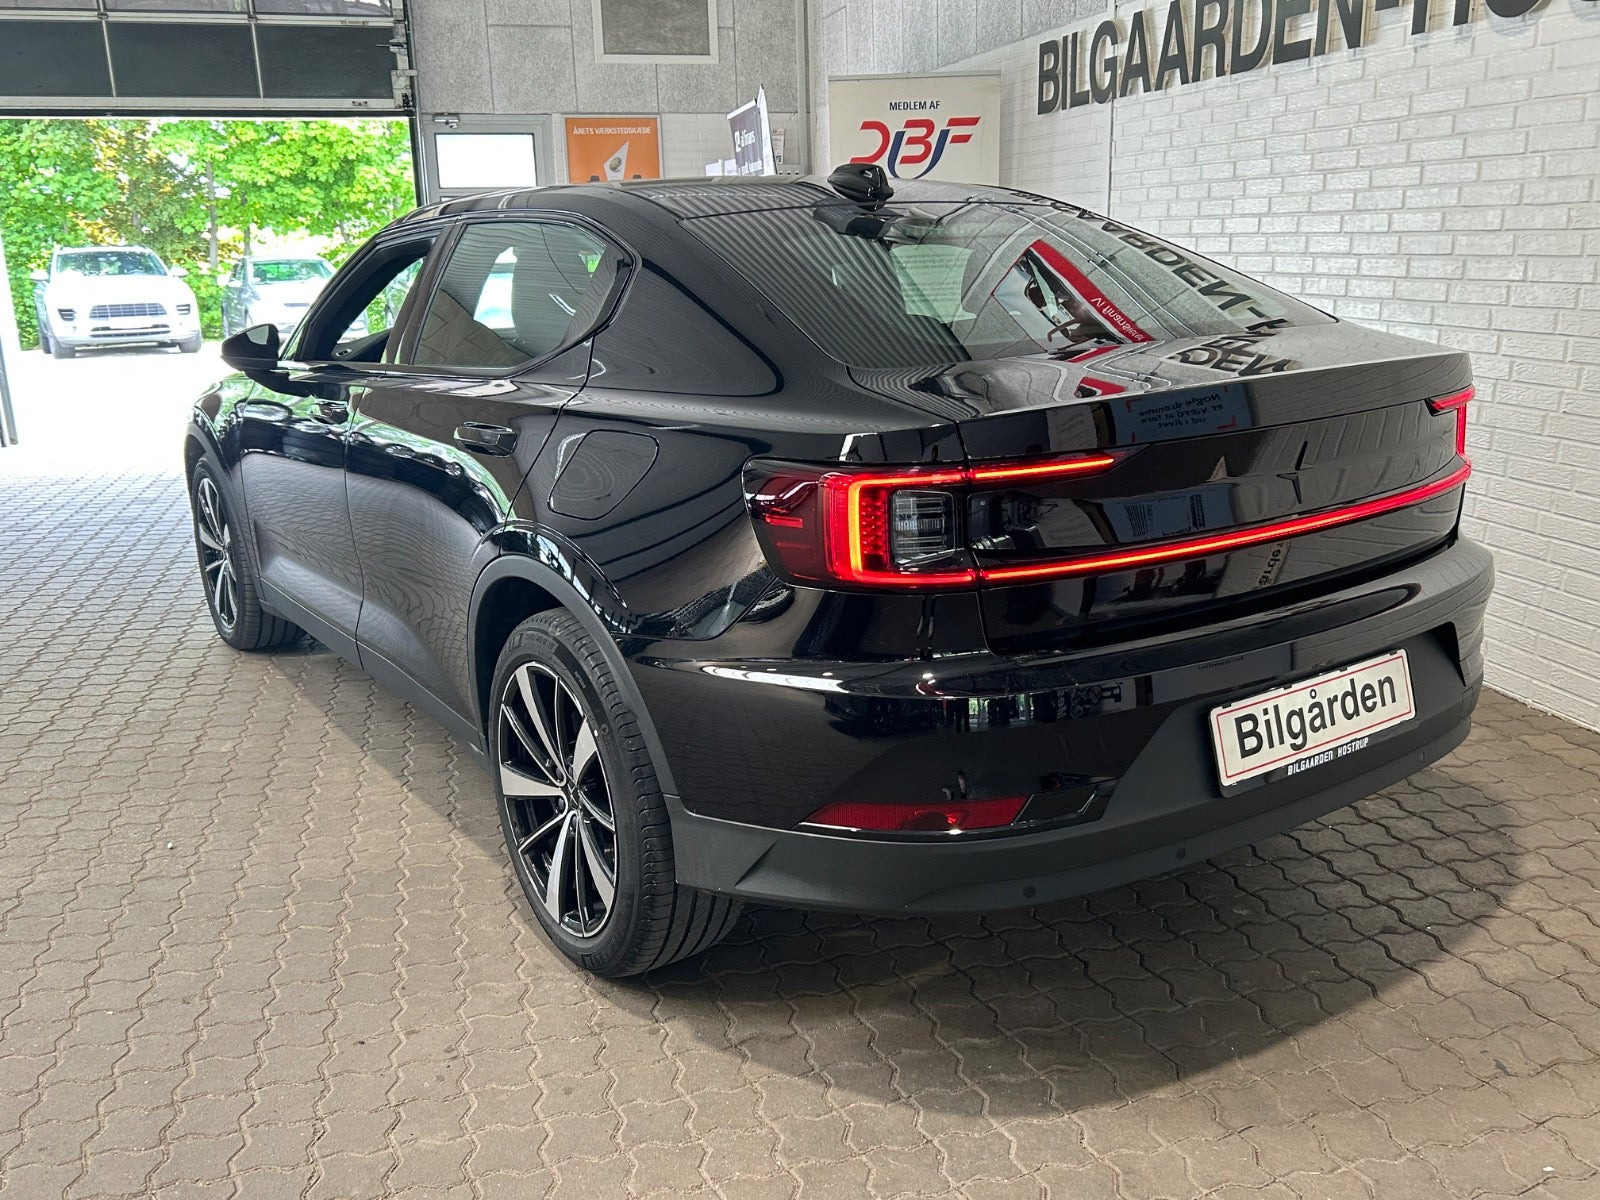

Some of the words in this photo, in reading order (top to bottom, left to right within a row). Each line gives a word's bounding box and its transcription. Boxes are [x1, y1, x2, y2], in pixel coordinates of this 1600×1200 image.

[889, 101, 927, 111] MEDLEM
[929, 100, 941, 110] AF
[573, 126, 594, 135] ÅRETS
[1234, 675, 1397, 759] Bilgården
[1287, 750, 1334, 776] BILGAARDEN
[1337, 738, 1369, 758] HOSTRUP
